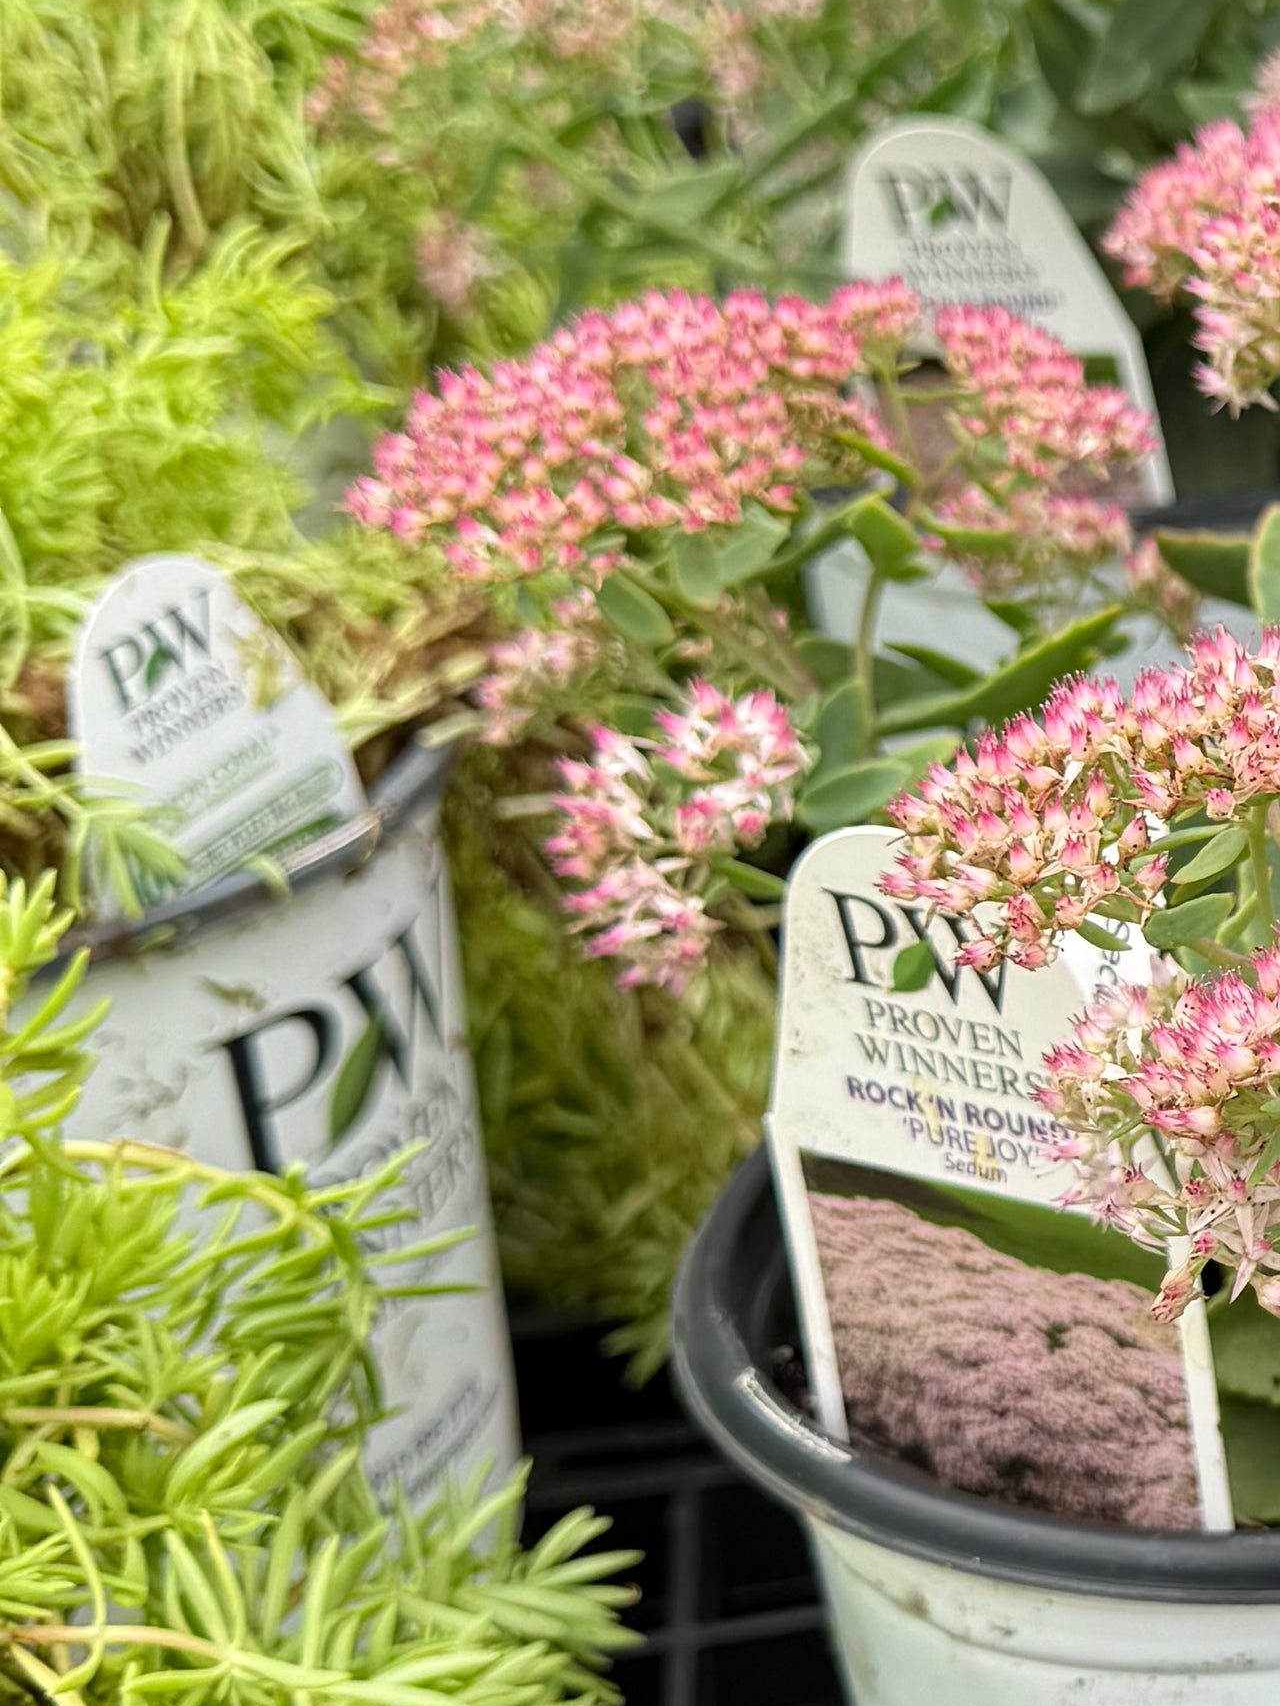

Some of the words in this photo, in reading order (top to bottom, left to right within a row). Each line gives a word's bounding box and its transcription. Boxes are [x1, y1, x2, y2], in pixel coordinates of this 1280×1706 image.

[876, 163, 1013, 235] PW
[97, 587, 214, 713] PW
[822, 886, 1010, 1017] PW
[862, 996, 1025, 1061] PROVEN
[854, 1031, 1048, 1099] WINNERS
[944, 1152, 1008, 1184] Sedum
